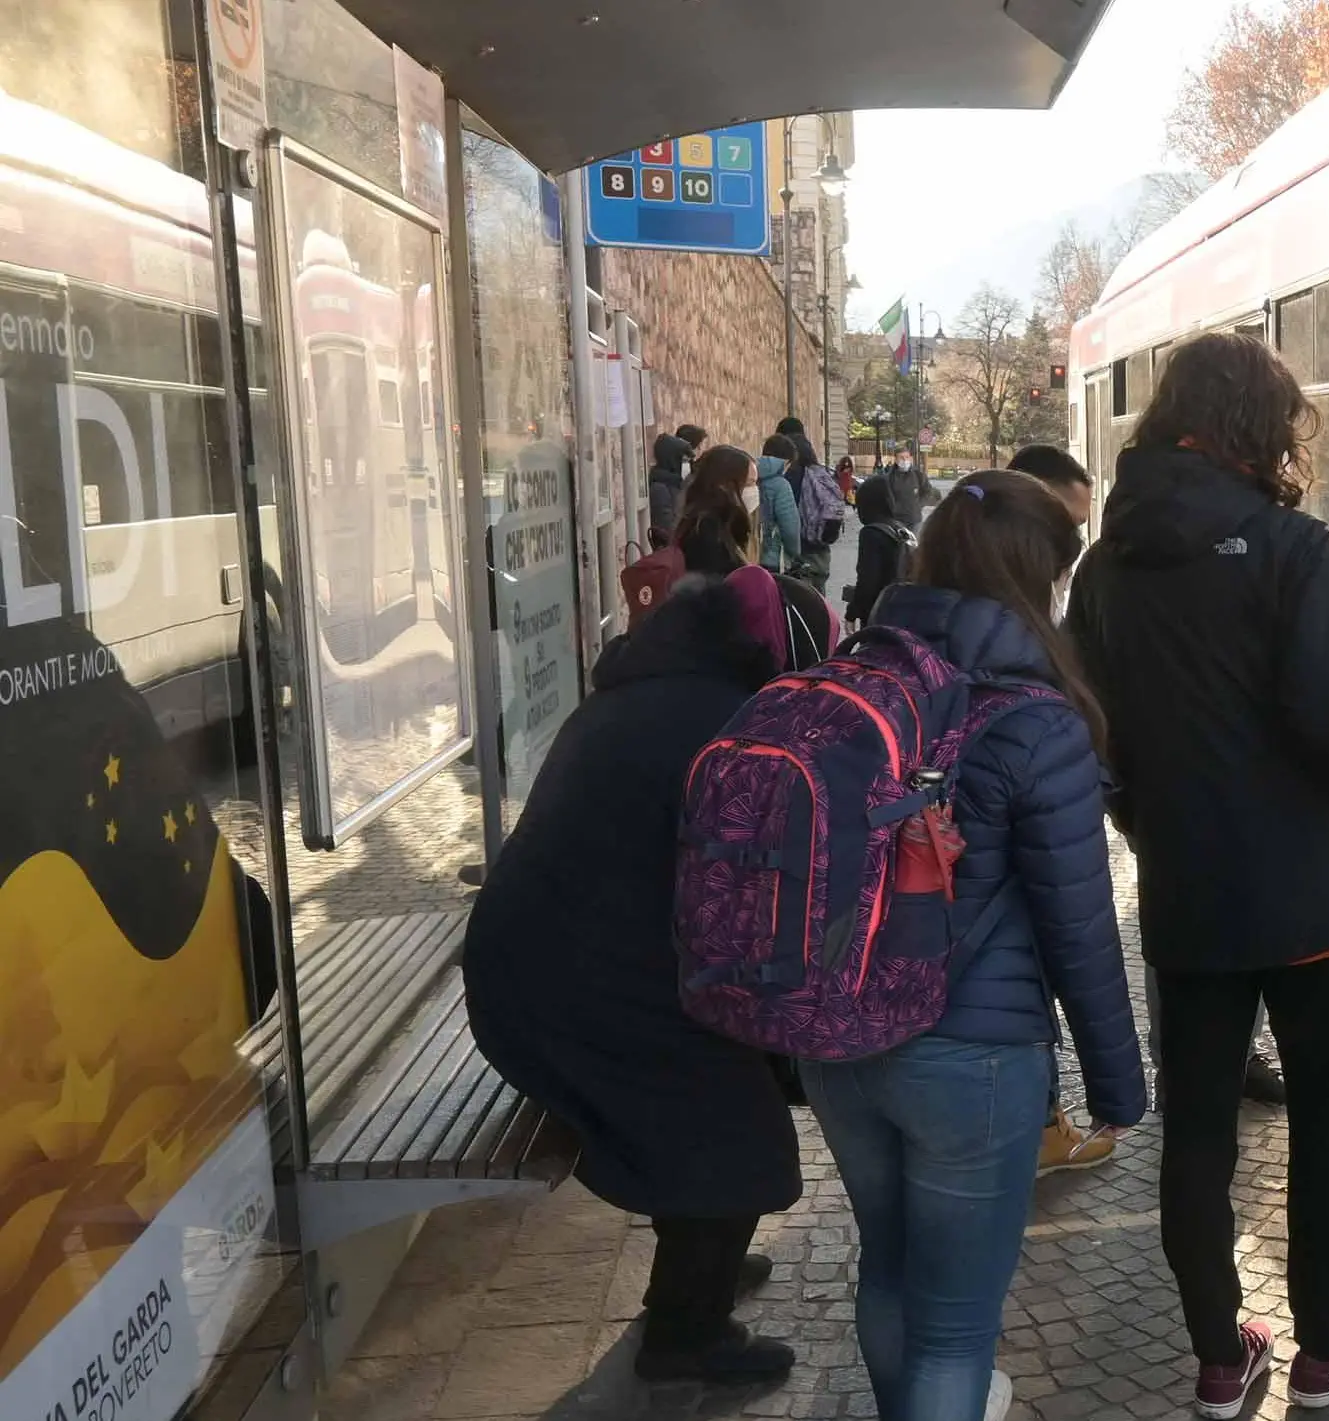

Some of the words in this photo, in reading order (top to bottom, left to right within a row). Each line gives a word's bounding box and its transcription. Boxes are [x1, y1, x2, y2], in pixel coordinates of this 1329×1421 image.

[649, 142, 663, 157] 3
[691, 143, 704, 159] 5
[728, 146, 741, 162] 7
[611, 174, 624, 191] 8
[652, 176, 665, 194] 9
[685, 178, 709, 197] 10
[66, 653, 77, 687] E
[72, 1353, 109, 1416] DEL
[112, 1278, 171, 1365] GARDA
